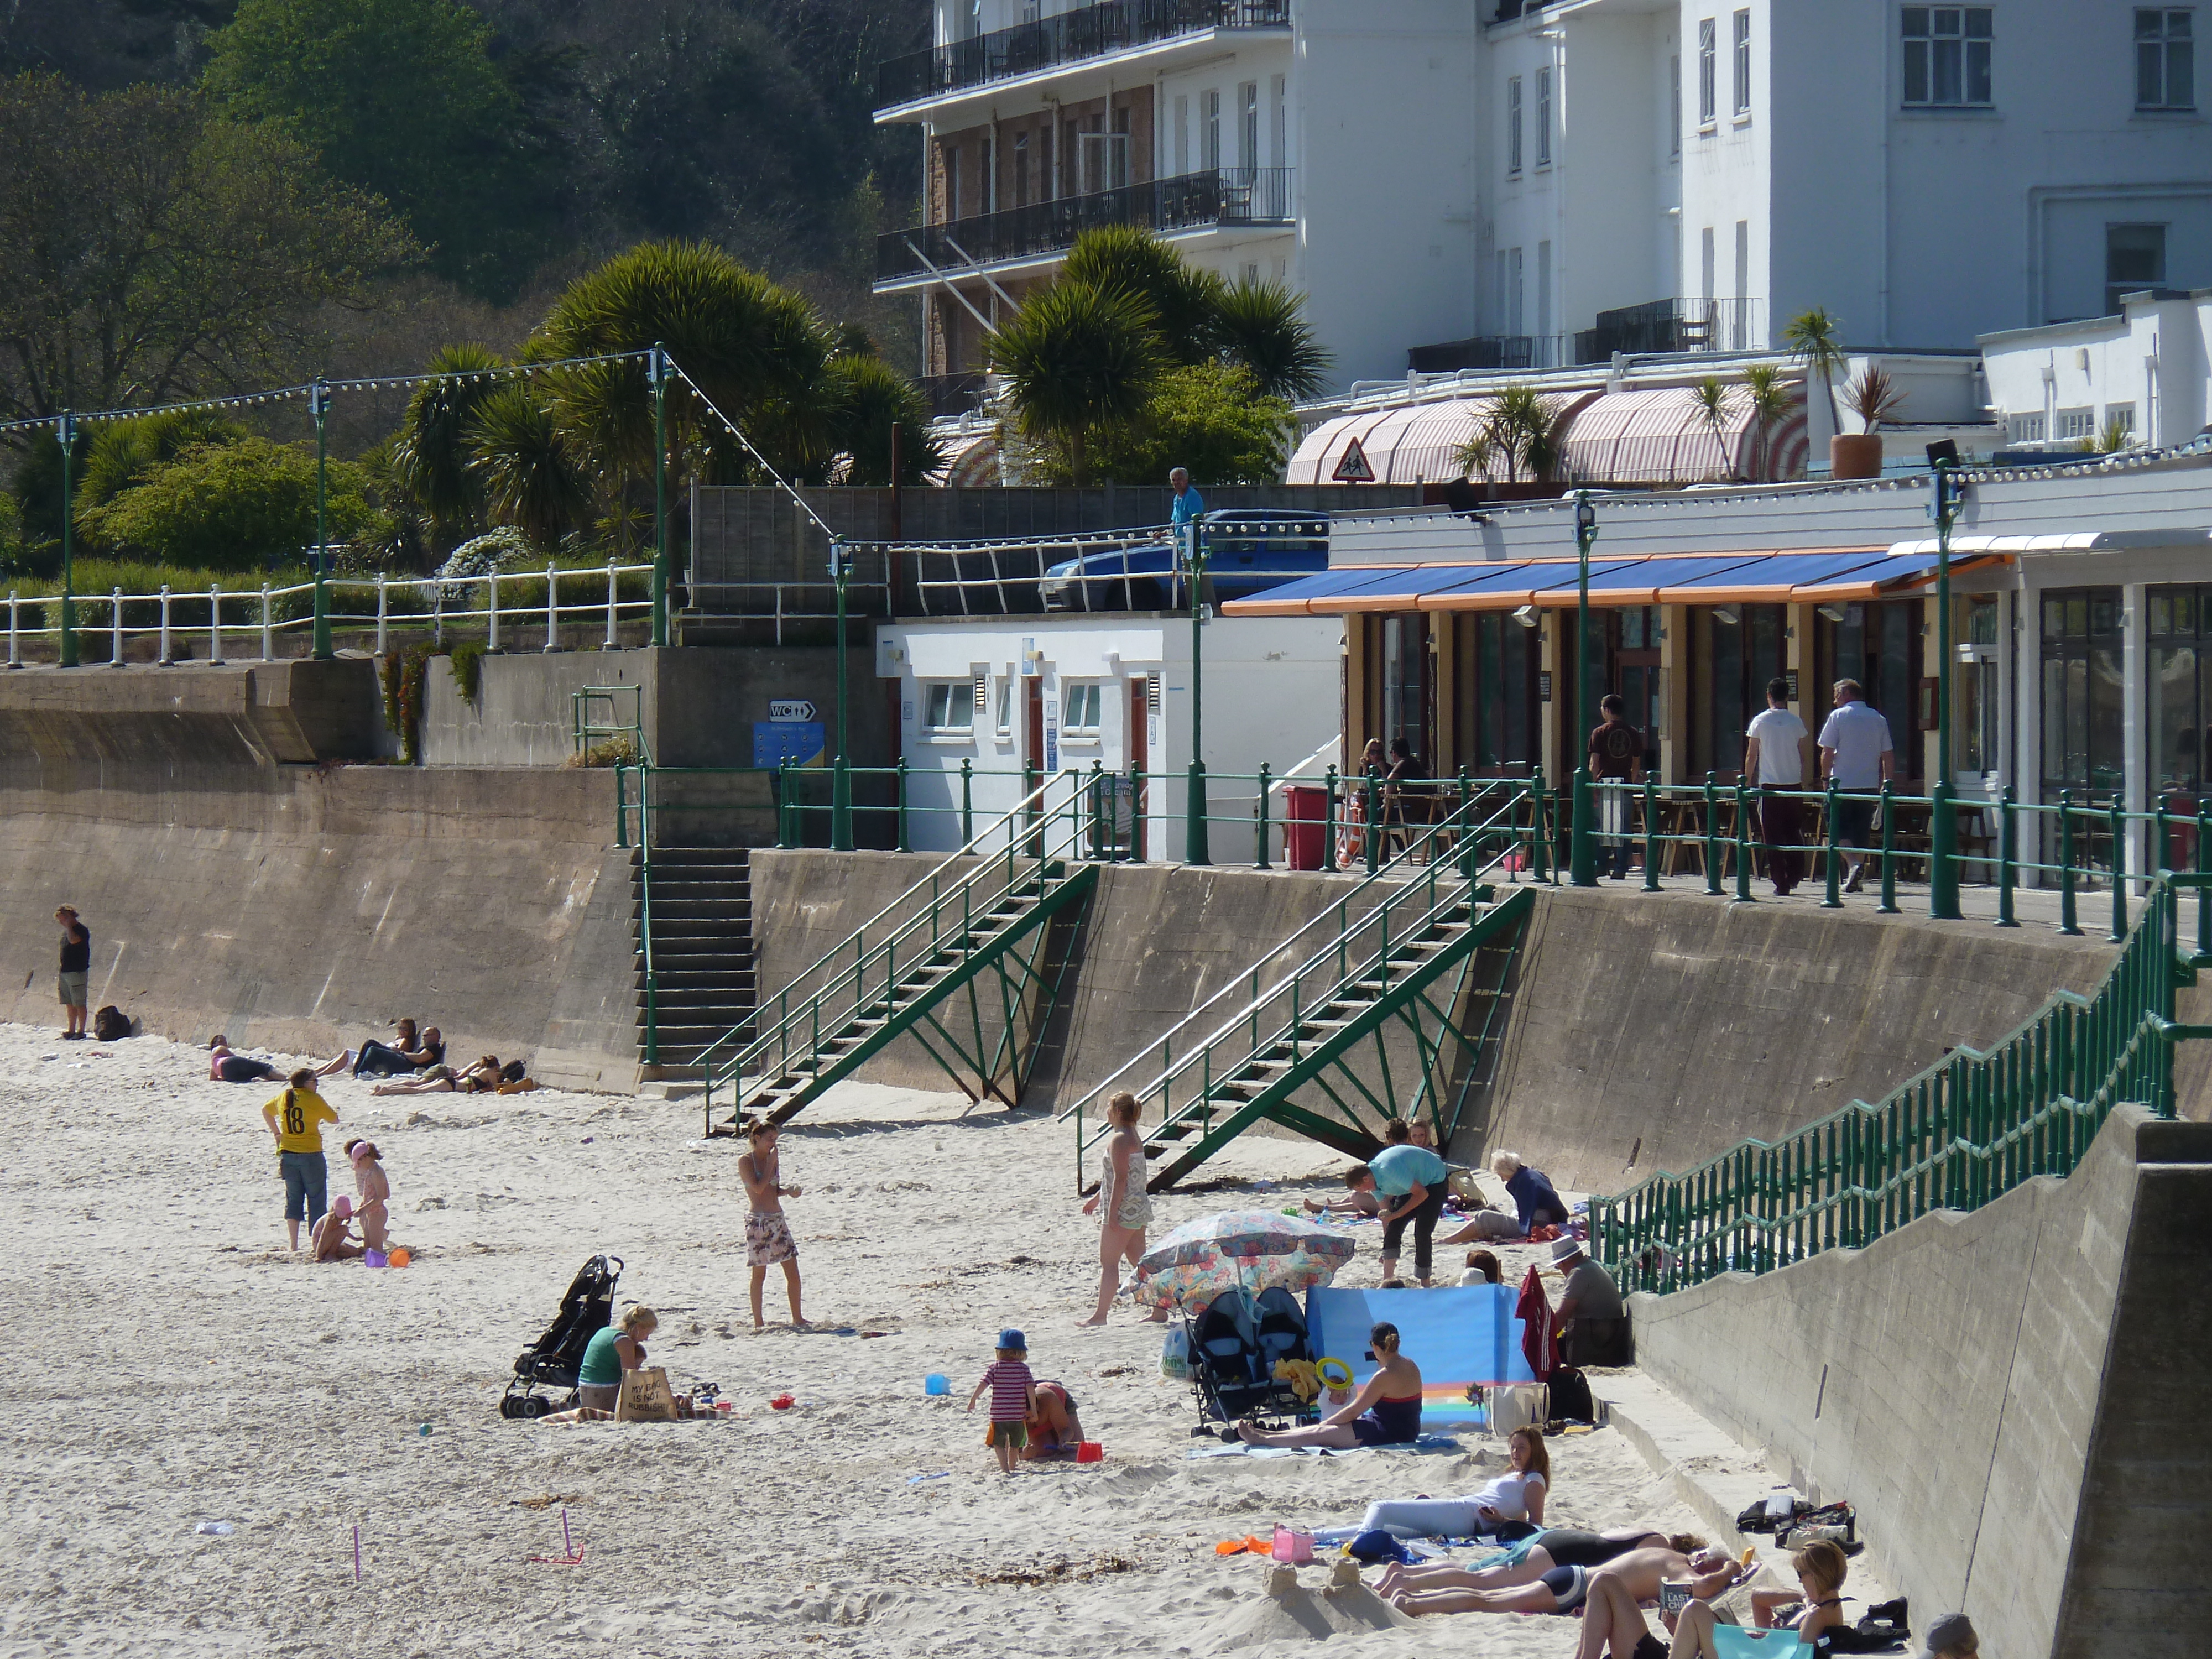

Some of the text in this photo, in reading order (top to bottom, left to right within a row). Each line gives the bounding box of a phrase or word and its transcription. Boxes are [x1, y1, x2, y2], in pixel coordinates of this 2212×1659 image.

[771, 706, 791, 716] WC
[283, 1107, 305, 1134] 18
[646, 1380, 661, 1391] BAG
[644, 1391, 660, 1402] NOT
[1668, 1601, 1686, 1610] CHI
